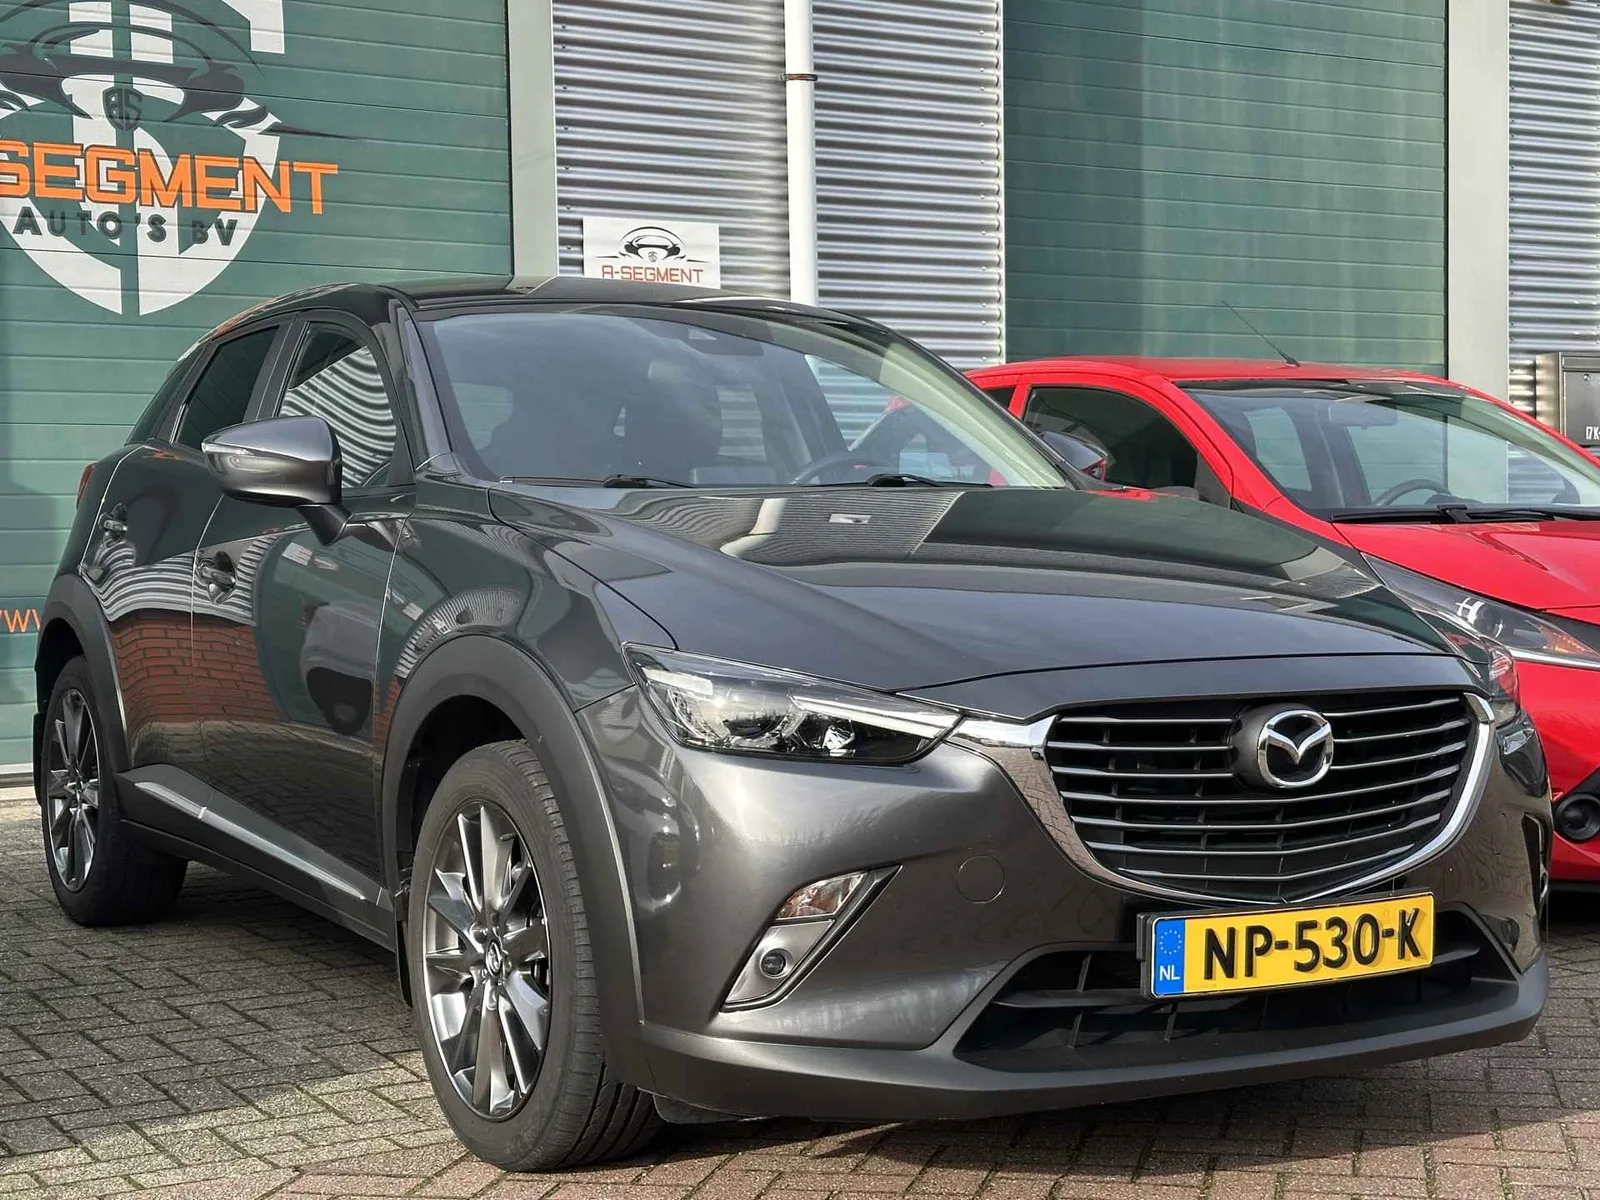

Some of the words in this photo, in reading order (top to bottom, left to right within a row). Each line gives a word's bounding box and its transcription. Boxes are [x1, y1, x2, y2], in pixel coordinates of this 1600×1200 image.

[12, 206, 167, 243] AUTO'S
[191, 218, 238, 247] BV
[601, 264, 704, 283] A-SEGMENT
[1203, 907, 1420, 980] NP-530-K
[1159, 964, 1180, 981] NL
